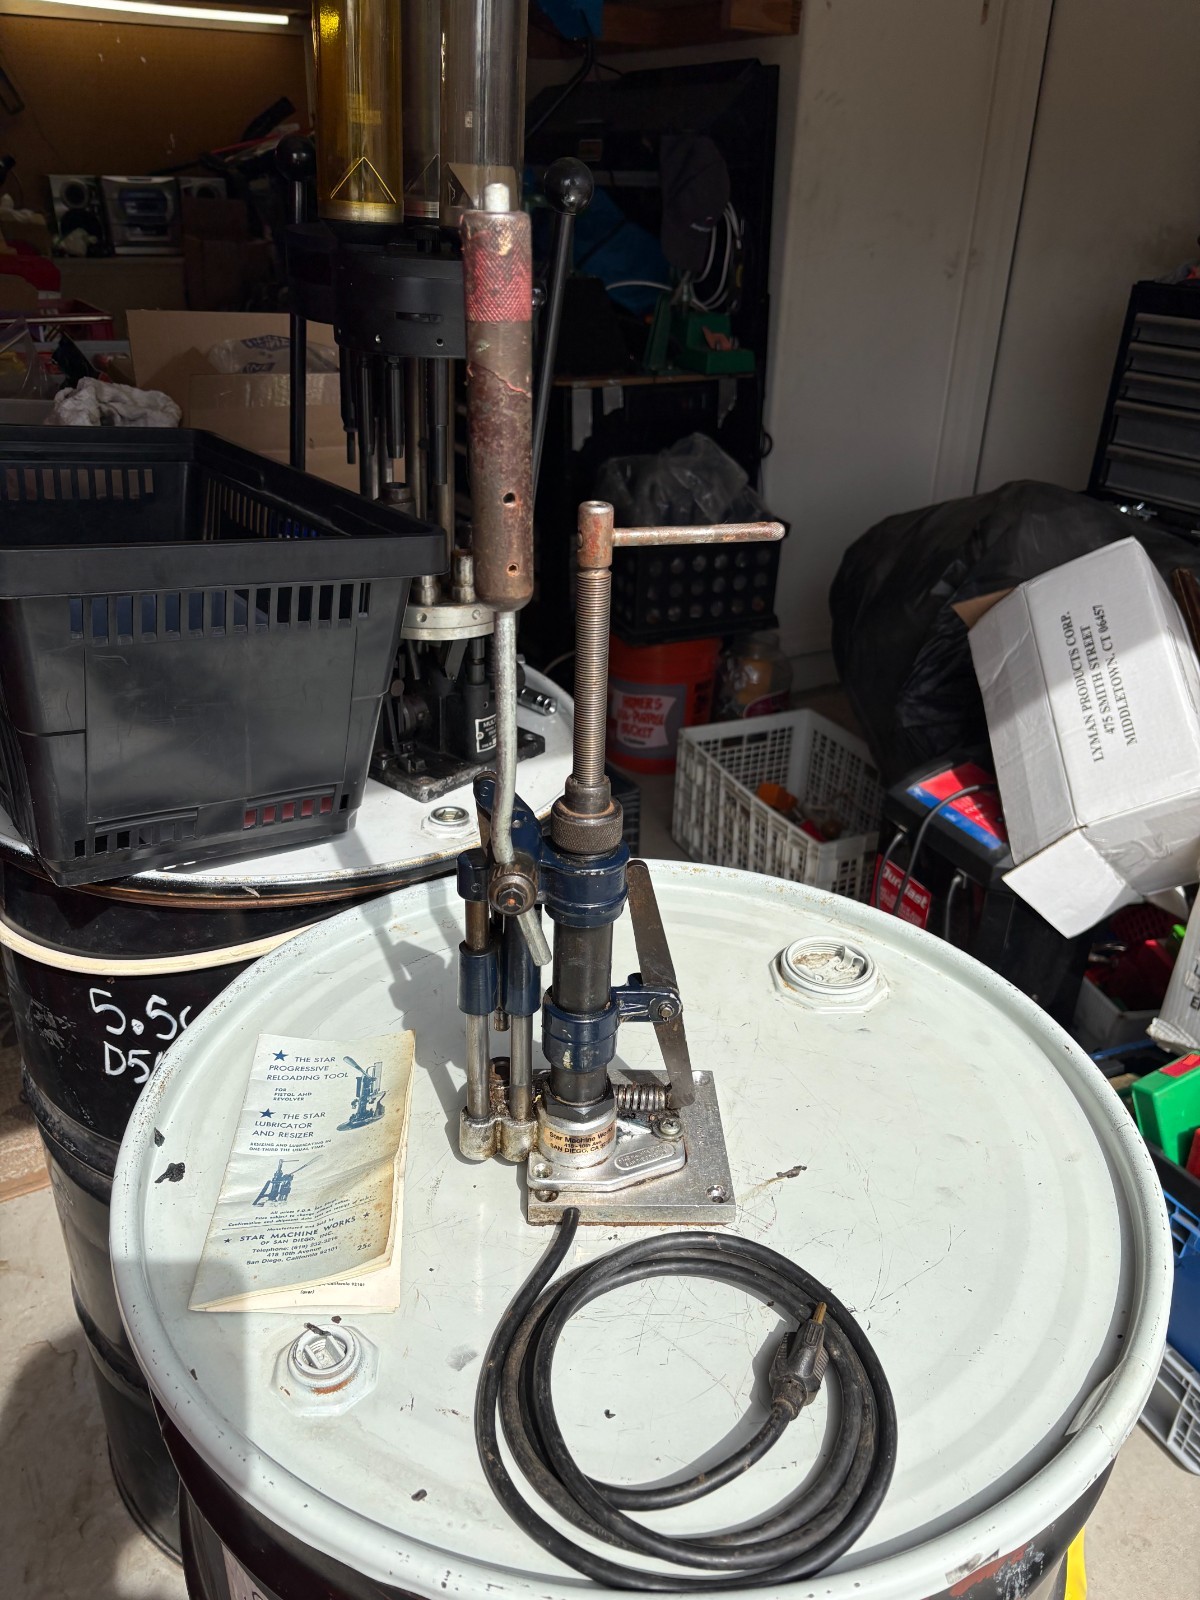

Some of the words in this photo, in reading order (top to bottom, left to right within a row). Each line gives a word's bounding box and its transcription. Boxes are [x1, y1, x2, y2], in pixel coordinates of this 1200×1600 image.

[1092, 604, 1109, 634] 06457
[1060, 610, 1077, 647] CORP.
[1079, 625, 1100, 671] STREET
[1100, 635, 1113, 652] CT
[1068, 647, 1092, 712] PRODUCTS
[1091, 671, 1111, 714] SMITH
[1101, 715, 1115, 734] 475
[1083, 713, 1105, 762] LYMAN
[268, 1064, 330, 1072] PROGRESSIVE
[324, 1072, 349, 1080] TOOL
[302, 1111, 326, 1120] STAR
[254, 1120, 313, 1129] LUBRICATOR
[251, 1129, 275, 1137] AND
[277, 1131, 314, 1139] RESIZER
[549, 1131, 563, 1141] Star
[564, 1136, 596, 1144] Machine
[288, 1140, 324, 1148] LUBRICATING
[550, 1143, 563, 1152] SAN
[239, 1234, 265, 1242] STAR
[270, 1229, 319, 1239] MACHINE
[323, 1215, 356, 1231] WORKS
[319, 1230, 334, 1239] INC.
[297, 1246, 322, 1254] Avenue
[285, 1252, 318, 1262] California
